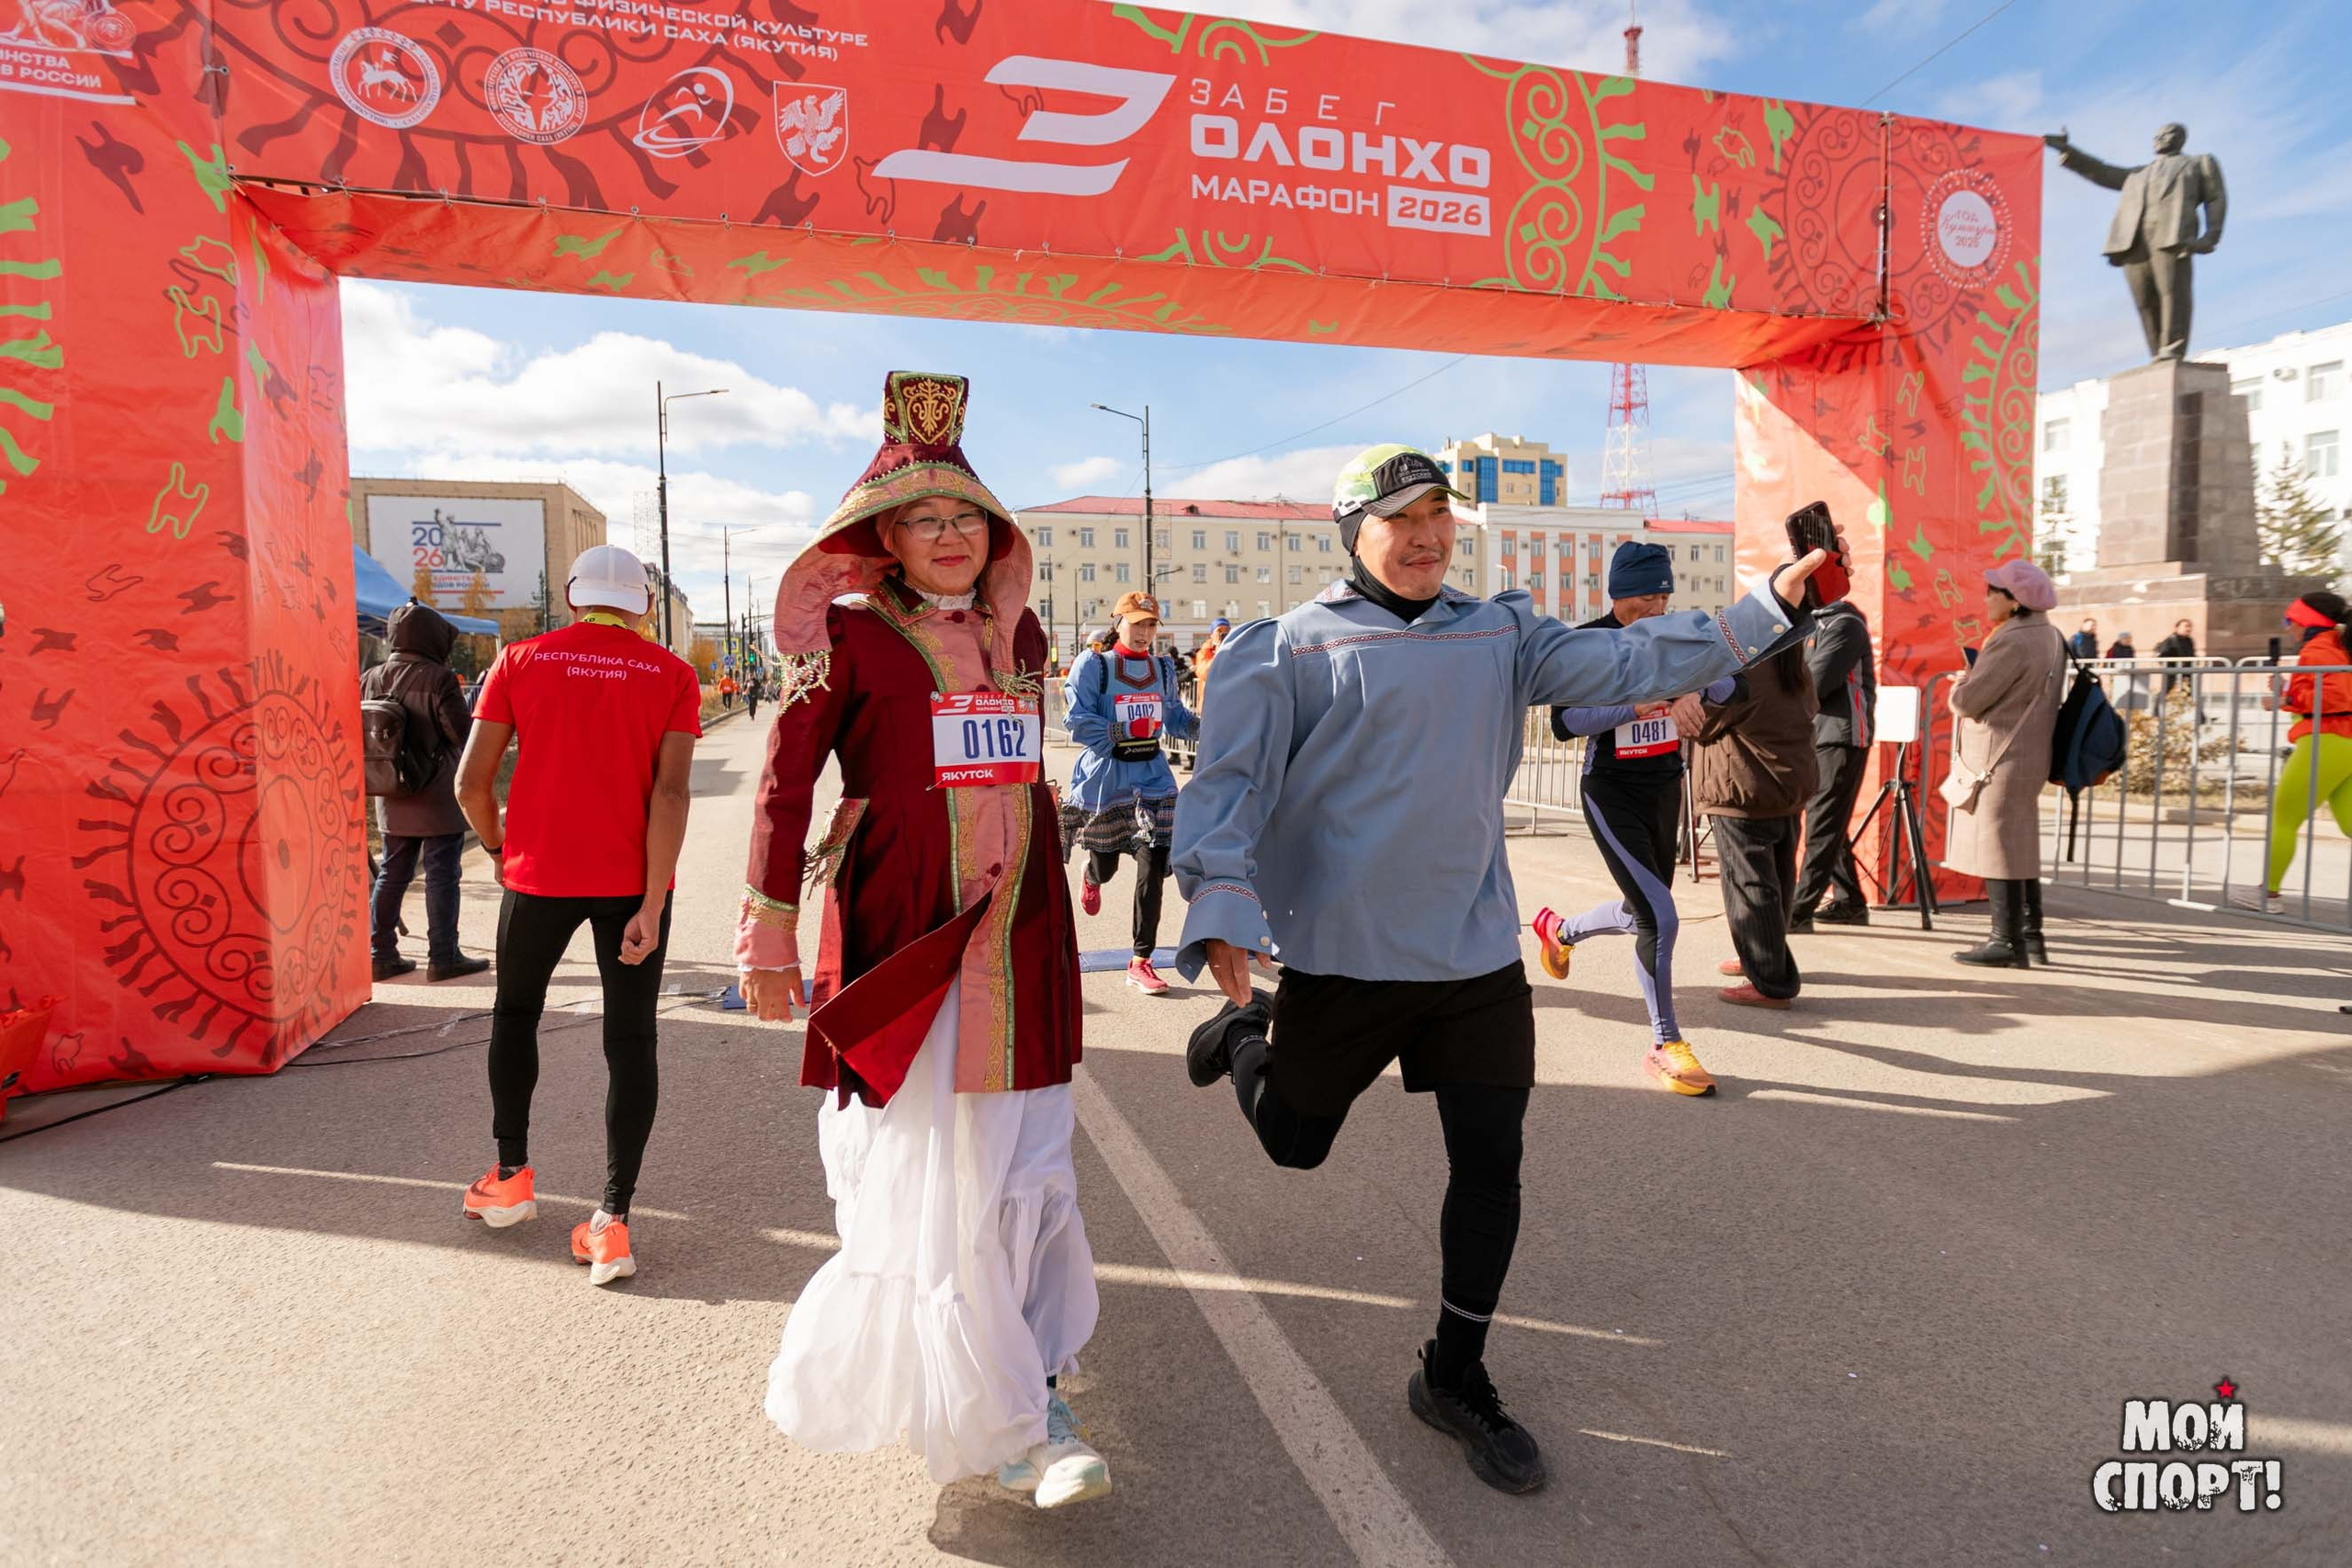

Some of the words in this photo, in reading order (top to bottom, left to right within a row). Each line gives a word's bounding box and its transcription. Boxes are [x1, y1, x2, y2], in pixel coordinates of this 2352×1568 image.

[485, 0, 657, 36] РЕСПУБЛИКИ
[663, 25, 728, 45] САХА
[733, 34, 838, 62] (ЯКУТИЯ)
[752, 20, 868, 47] КУЛЬТУРЕ
[20, 66, 102, 88] РОССИИ
[1190, 77, 1396, 126] ЗАБЕГ
[1190, 113, 1491, 188] ОЛОНХО
[1192, 174, 1379, 217] МАРАФОН
[1396, 196, 1483, 227] 2026
[412, 526, 443, 547] 20
[413, 547, 444, 568] 26
[534, 651, 624, 666] РЕСПУБЛИКА
[628, 659, 661, 673] САХА
[567, 665, 627, 681] (ЯКУТИЯ)
[963, 718, 1027, 759] 0162
[1632, 719, 1667, 744] 0481
[941, 769, 994, 781] ЯКУТСК
